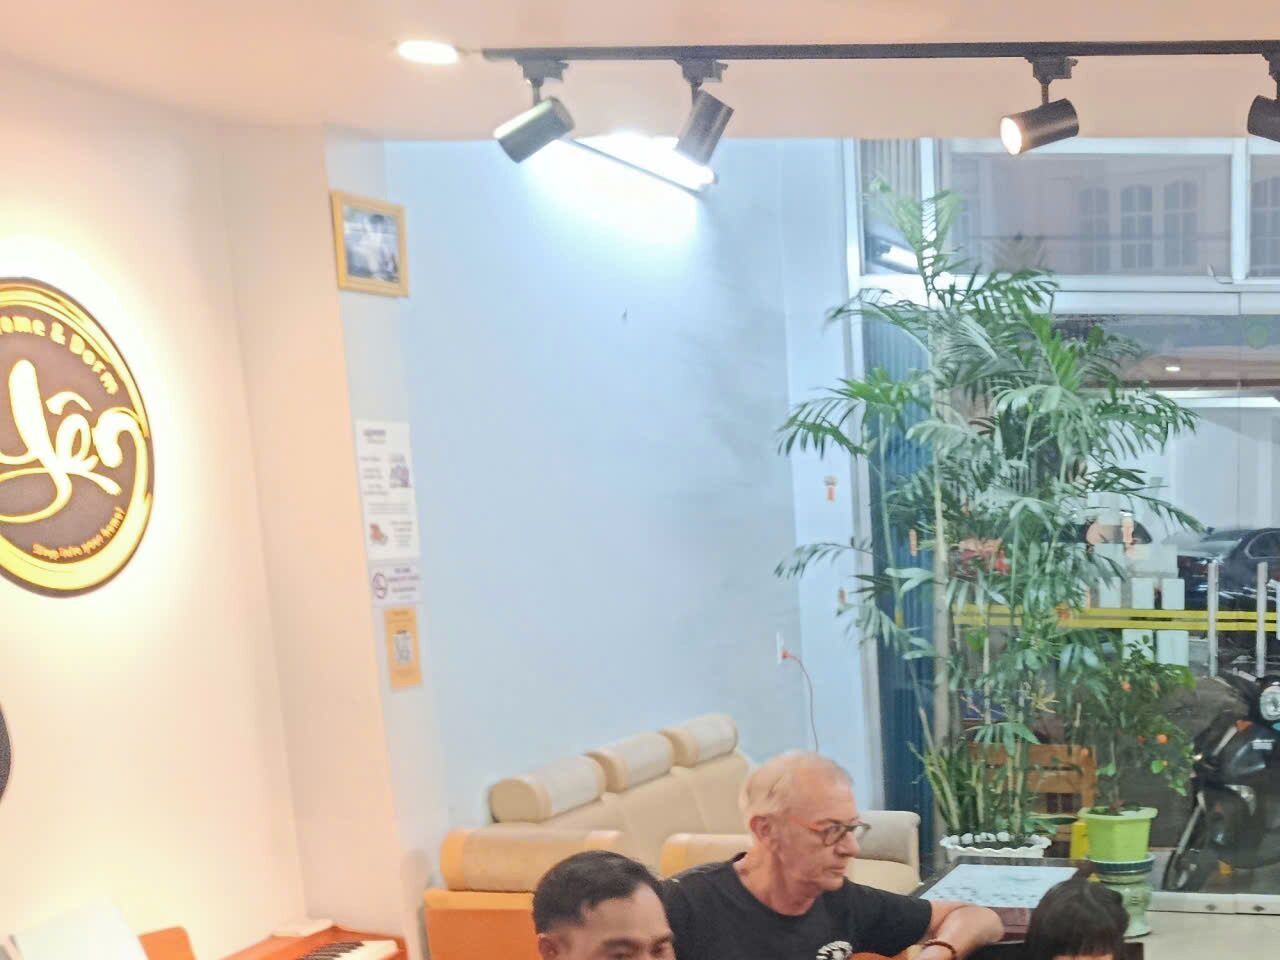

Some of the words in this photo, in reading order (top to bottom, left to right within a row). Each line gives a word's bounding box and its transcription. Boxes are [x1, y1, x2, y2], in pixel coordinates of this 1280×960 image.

[0, 314, 46, 337] ome
[49, 321, 66, 346] &
[69, 333, 119, 395] Dorm
